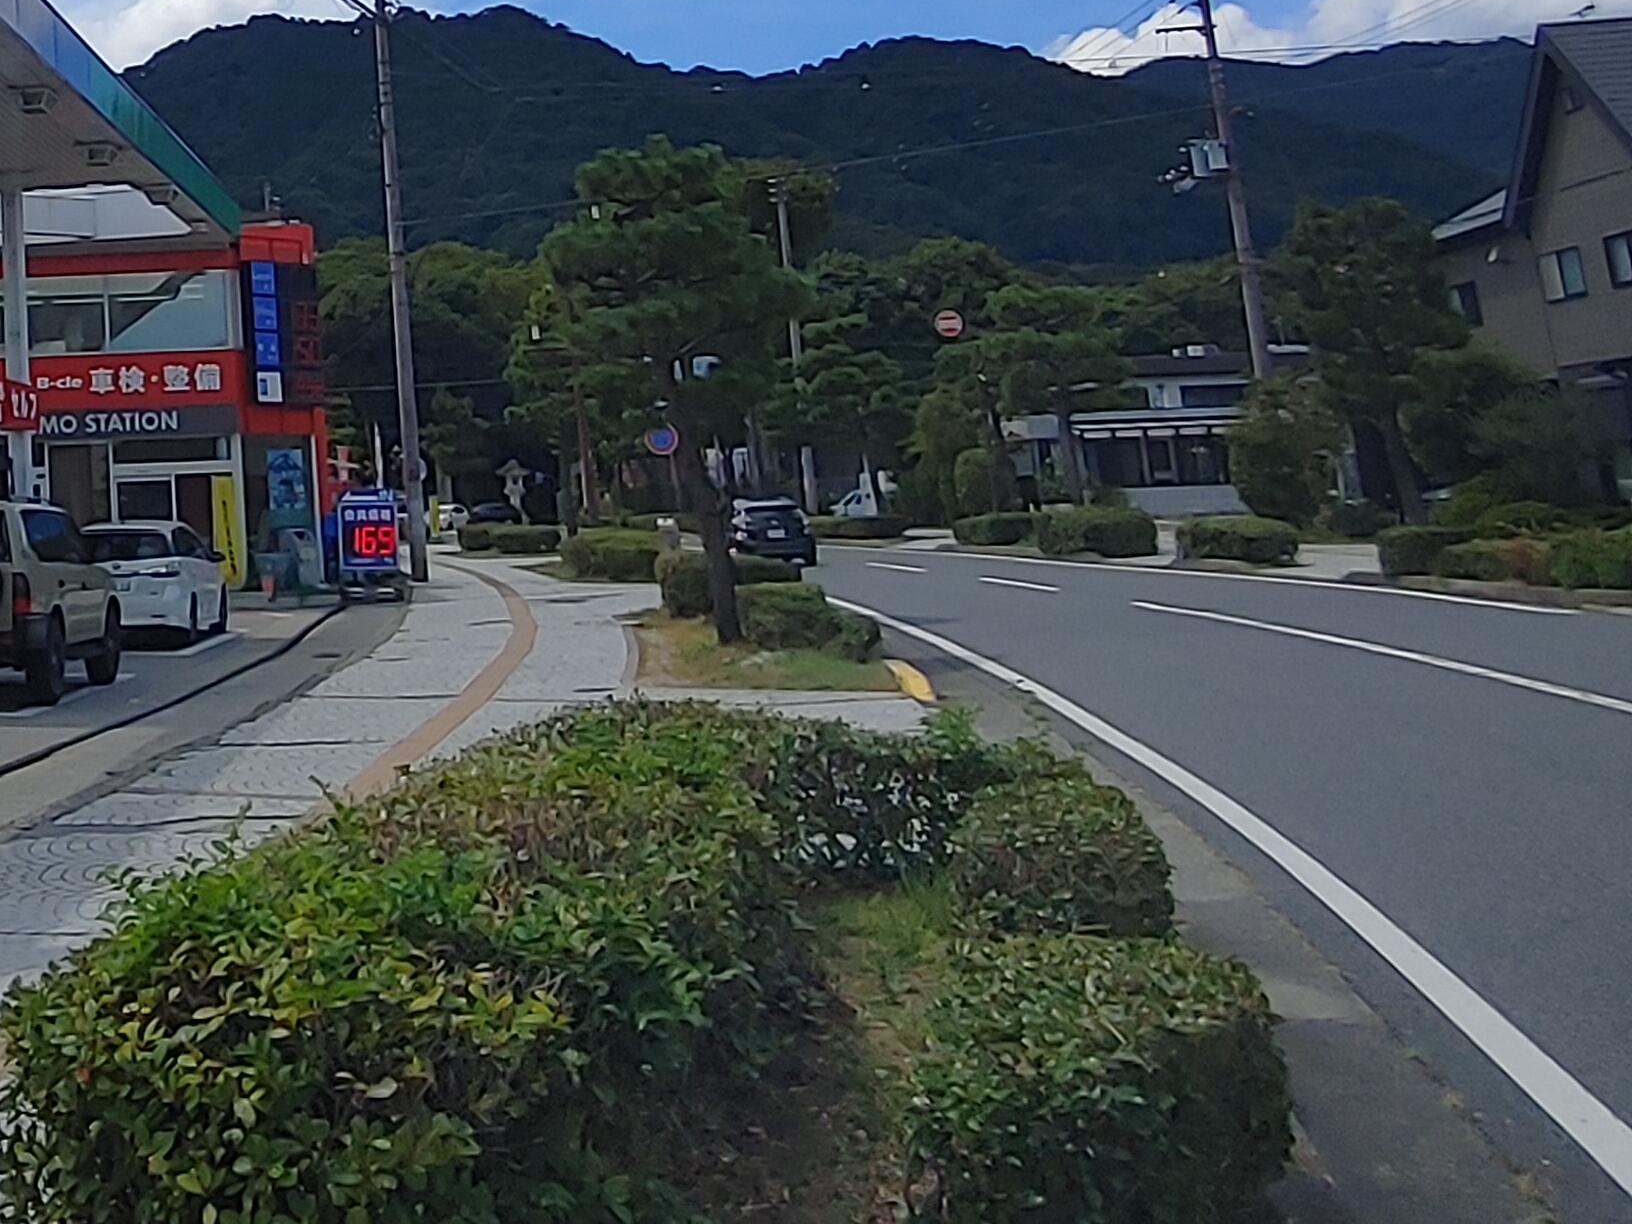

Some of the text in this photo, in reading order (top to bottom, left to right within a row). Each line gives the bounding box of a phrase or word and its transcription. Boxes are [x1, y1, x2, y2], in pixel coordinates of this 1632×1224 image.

[39, 411, 178, 435] MO STATION
[354, 527, 395, 555] 169
